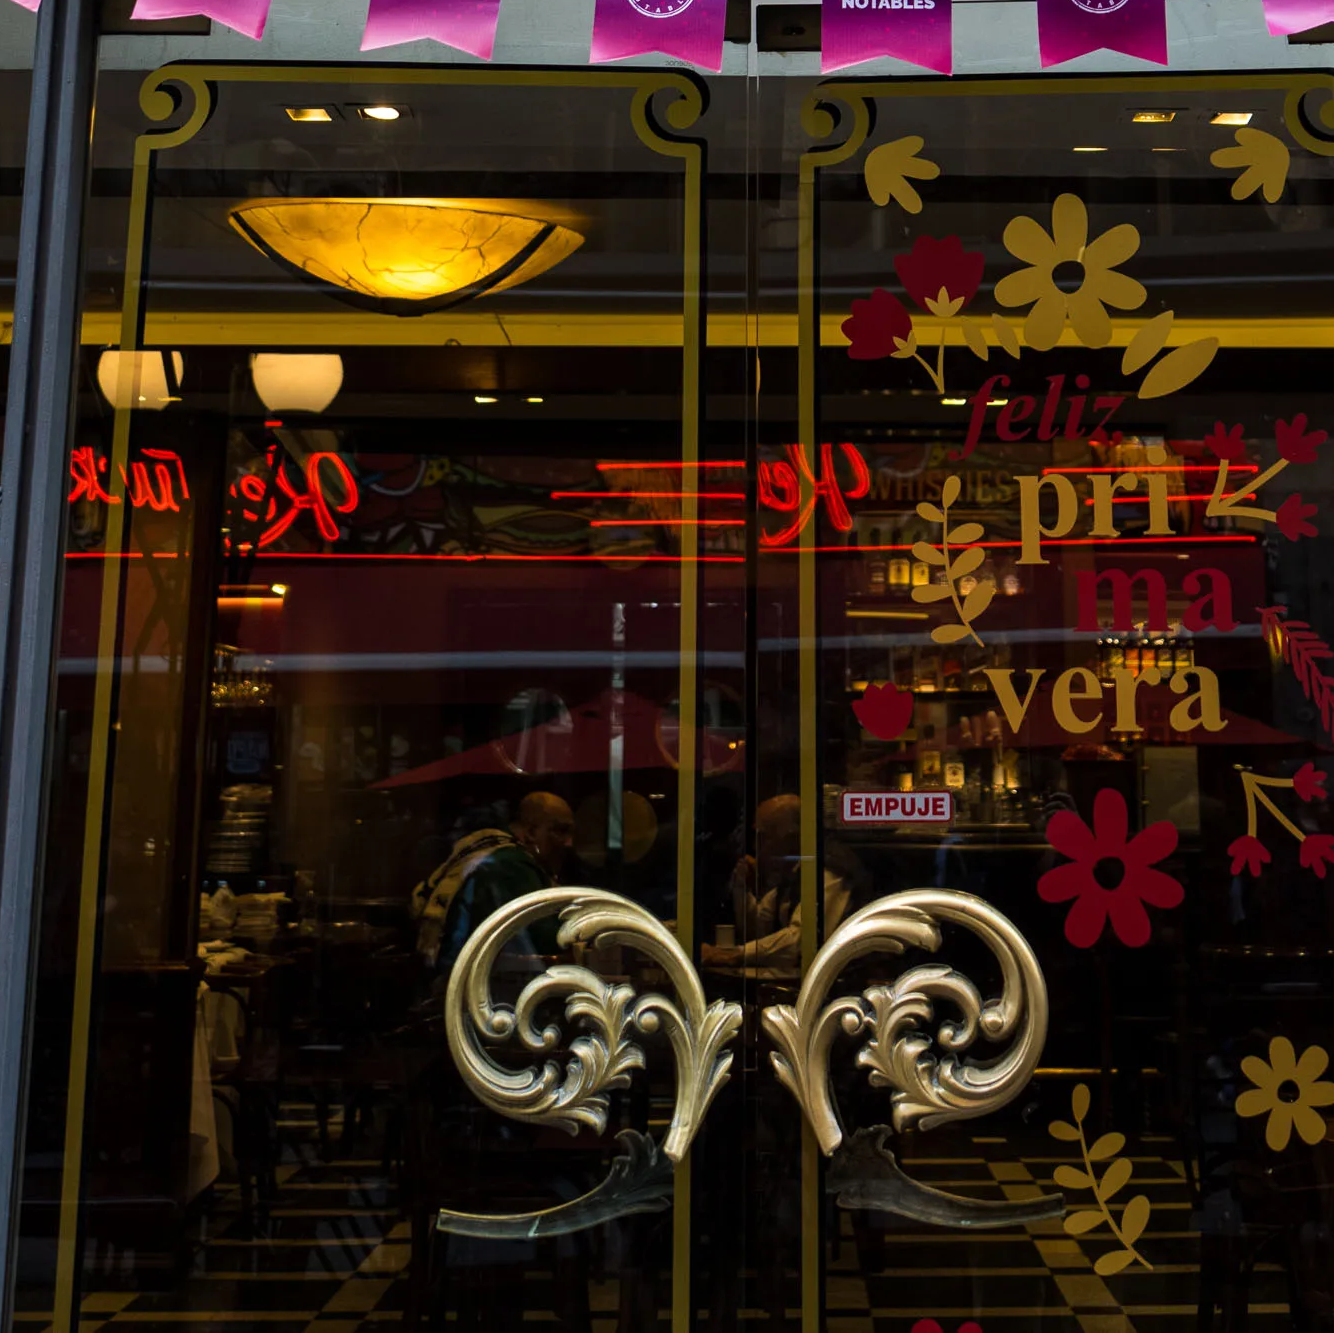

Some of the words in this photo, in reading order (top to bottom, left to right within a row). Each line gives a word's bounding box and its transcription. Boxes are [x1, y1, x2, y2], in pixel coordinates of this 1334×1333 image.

[949, 373, 1126, 461] feliz
[1013, 446, 1176, 564] pri
[1074, 567, 1240, 633] ma
[983, 665, 1228, 735] vera
[849, 797, 946, 818] EMPUJE
